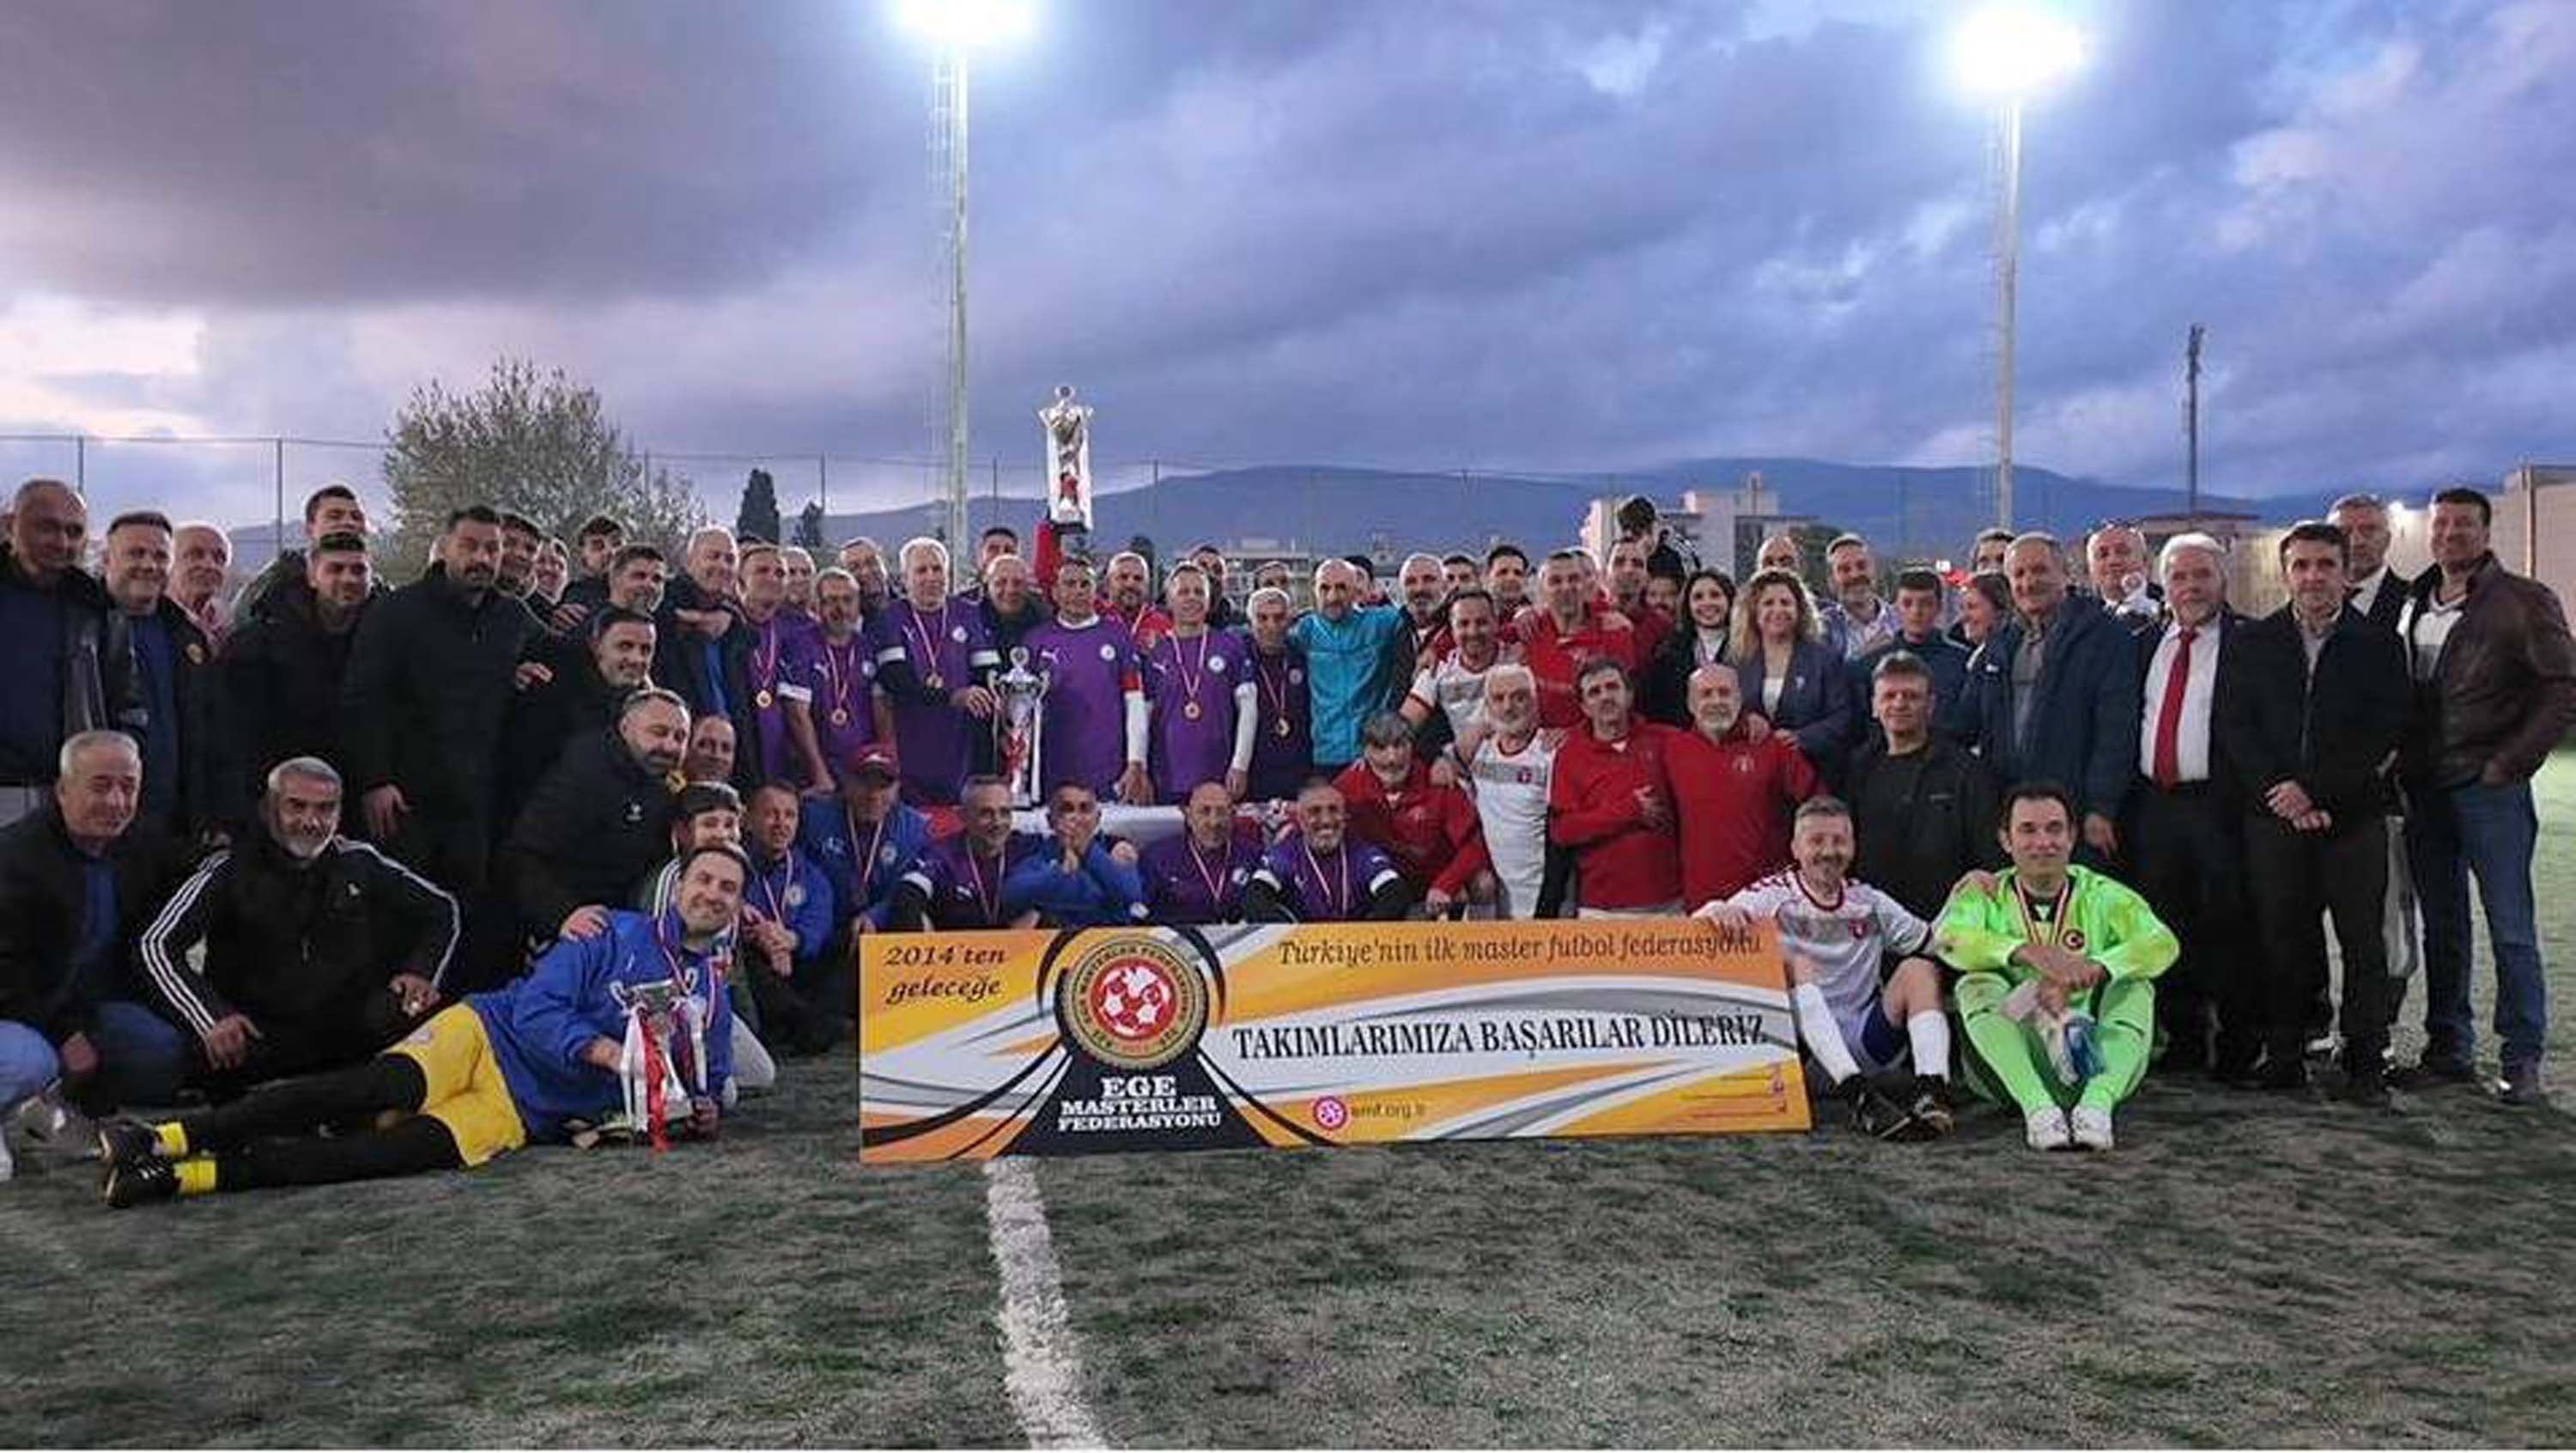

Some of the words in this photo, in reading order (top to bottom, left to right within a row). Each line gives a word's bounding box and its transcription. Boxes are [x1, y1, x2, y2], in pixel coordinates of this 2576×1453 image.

[1425, 936, 1455, 962] ilk
[1462, 936, 1545, 963] master
[1547, 933, 1615, 963] futbol
[1231, 1022, 1474, 1060] TAKIMLARIMIZA
[1479, 1015, 1646, 1060] BAŞARILAR
[1650, 1006, 1765, 1048] DİLERİZ
[1100, 1075, 1177, 1098] EGE
[1060, 1095, 1217, 1116] MASTERLER
[1057, 1112, 1222, 1132] FEDERASYONU
